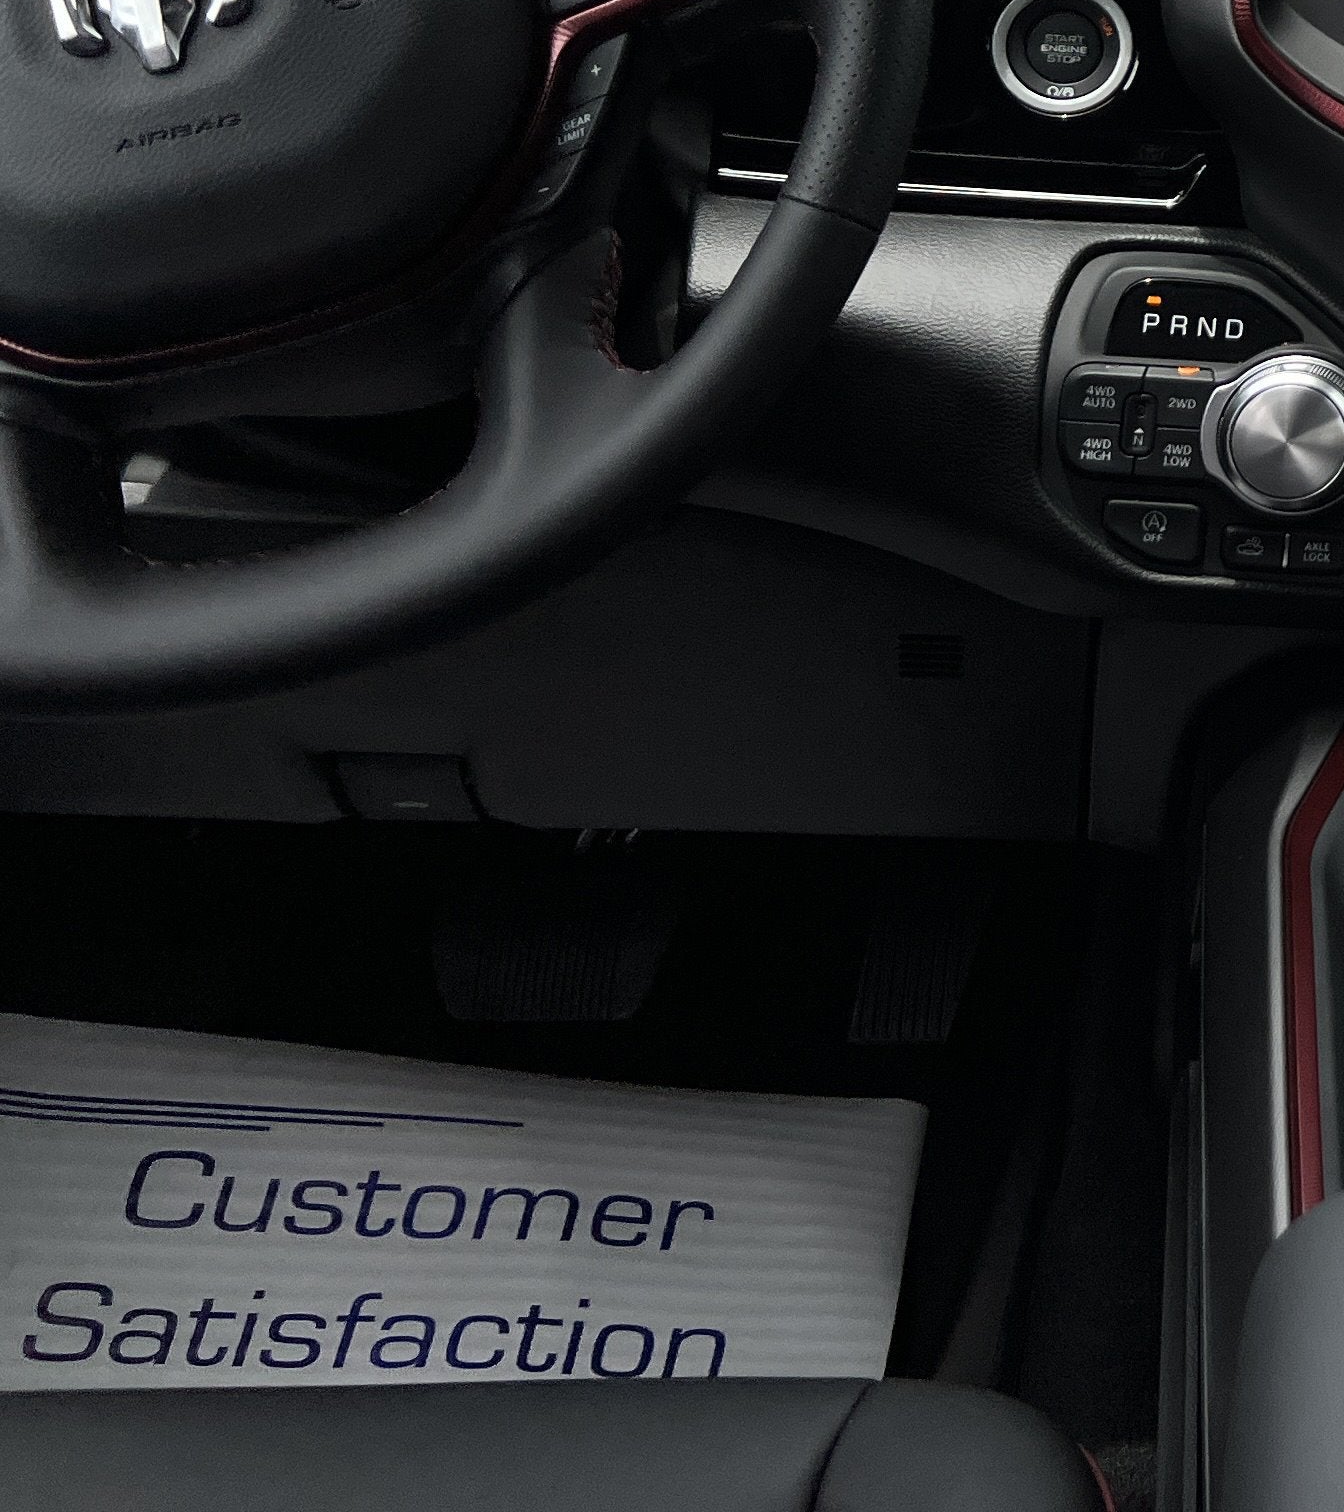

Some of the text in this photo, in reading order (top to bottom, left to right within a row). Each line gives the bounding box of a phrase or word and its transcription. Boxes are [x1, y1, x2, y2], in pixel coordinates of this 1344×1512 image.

[1044, 33, 1086, 44] START
[1040, 43, 1089, 55] ENGINE
[1046, 54, 1082, 65] STOP
[557, 128, 586, 146] LIMIT
[1086, 384, 1116, 397] 4WD
[1082, 396, 1116, 409] AUTO
[1168, 397, 1197, 409] 2WD
[1082, 437, 1112, 449] 4WD
[1163, 443, 1192, 455] 4WD
[1080, 448, 1112, 462] HIGH
[1163, 455, 1192, 468] LOW
[1302, 551, 1331, 563] LOCK
[123, 1149, 716, 1252] Customer
[21, 1280, 728, 1380] Satisfaction
